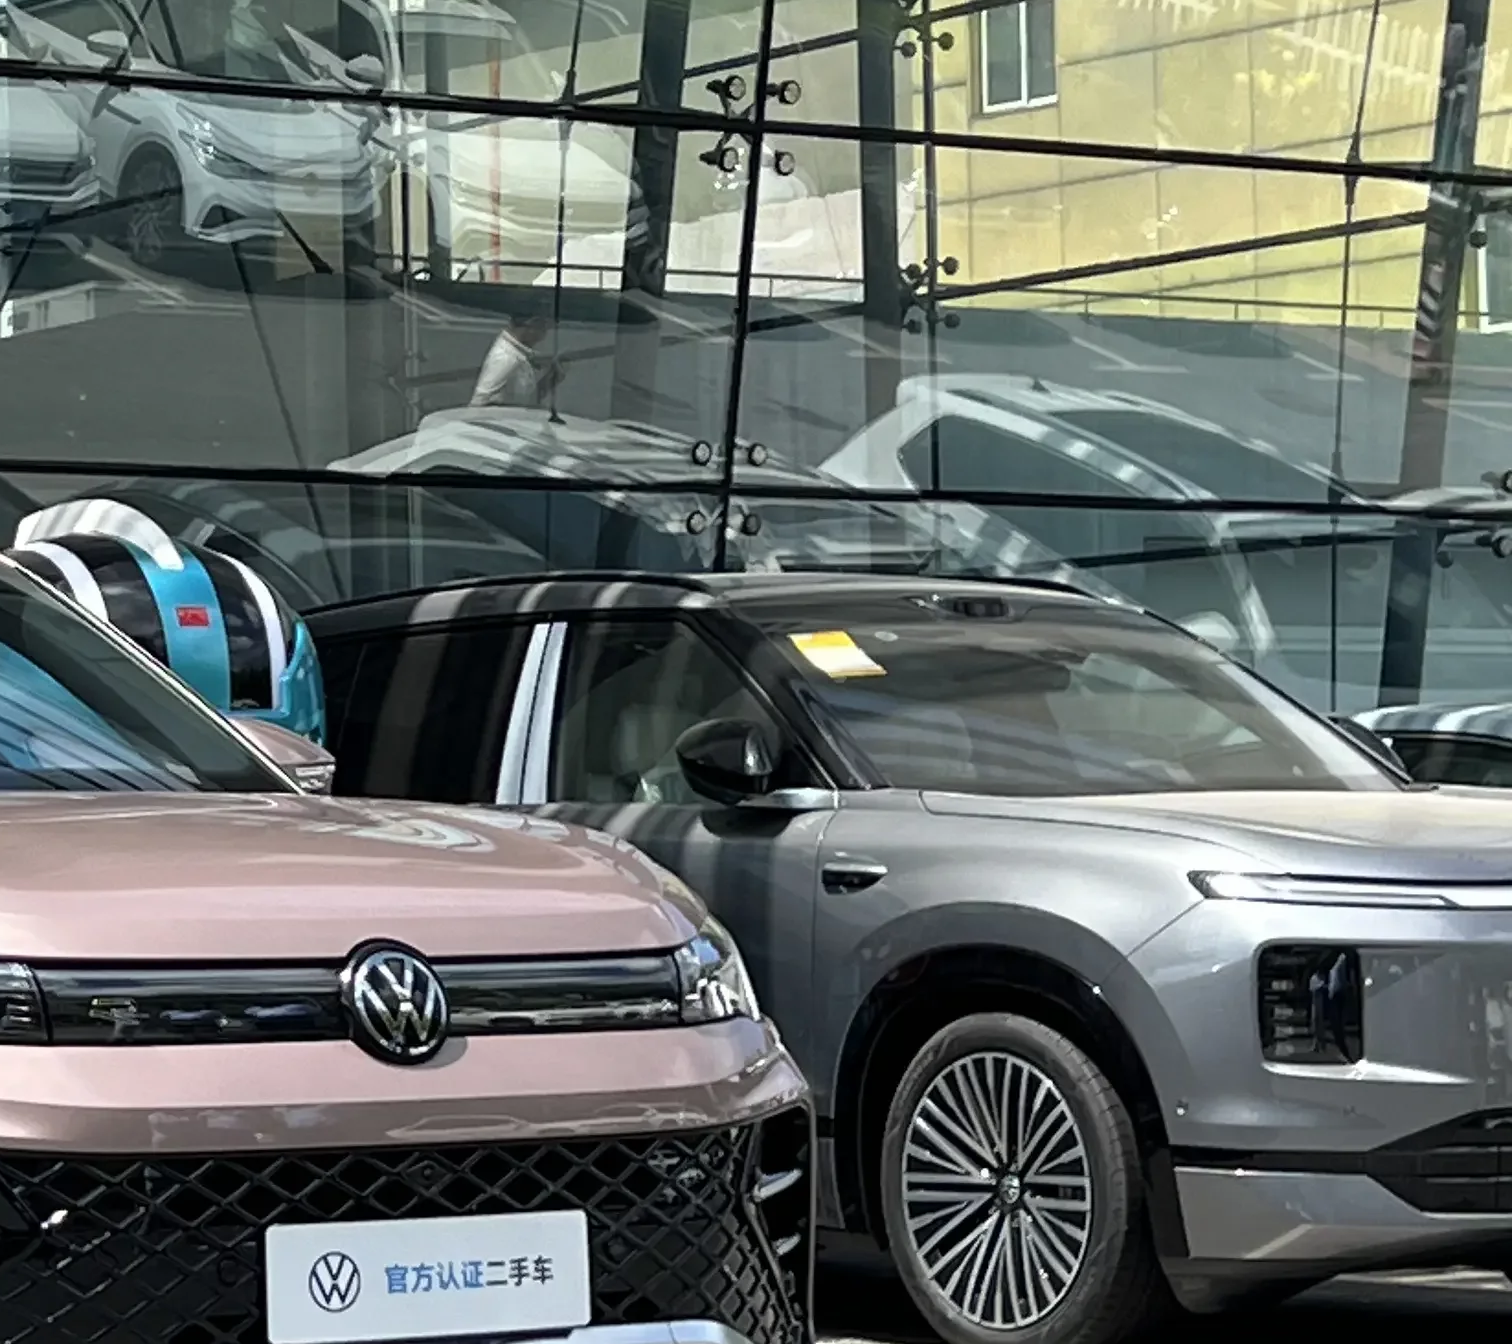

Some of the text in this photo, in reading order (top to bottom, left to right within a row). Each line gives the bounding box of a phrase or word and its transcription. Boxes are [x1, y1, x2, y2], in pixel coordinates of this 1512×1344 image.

[384, 1254, 554, 1295] 官方认证二手车
